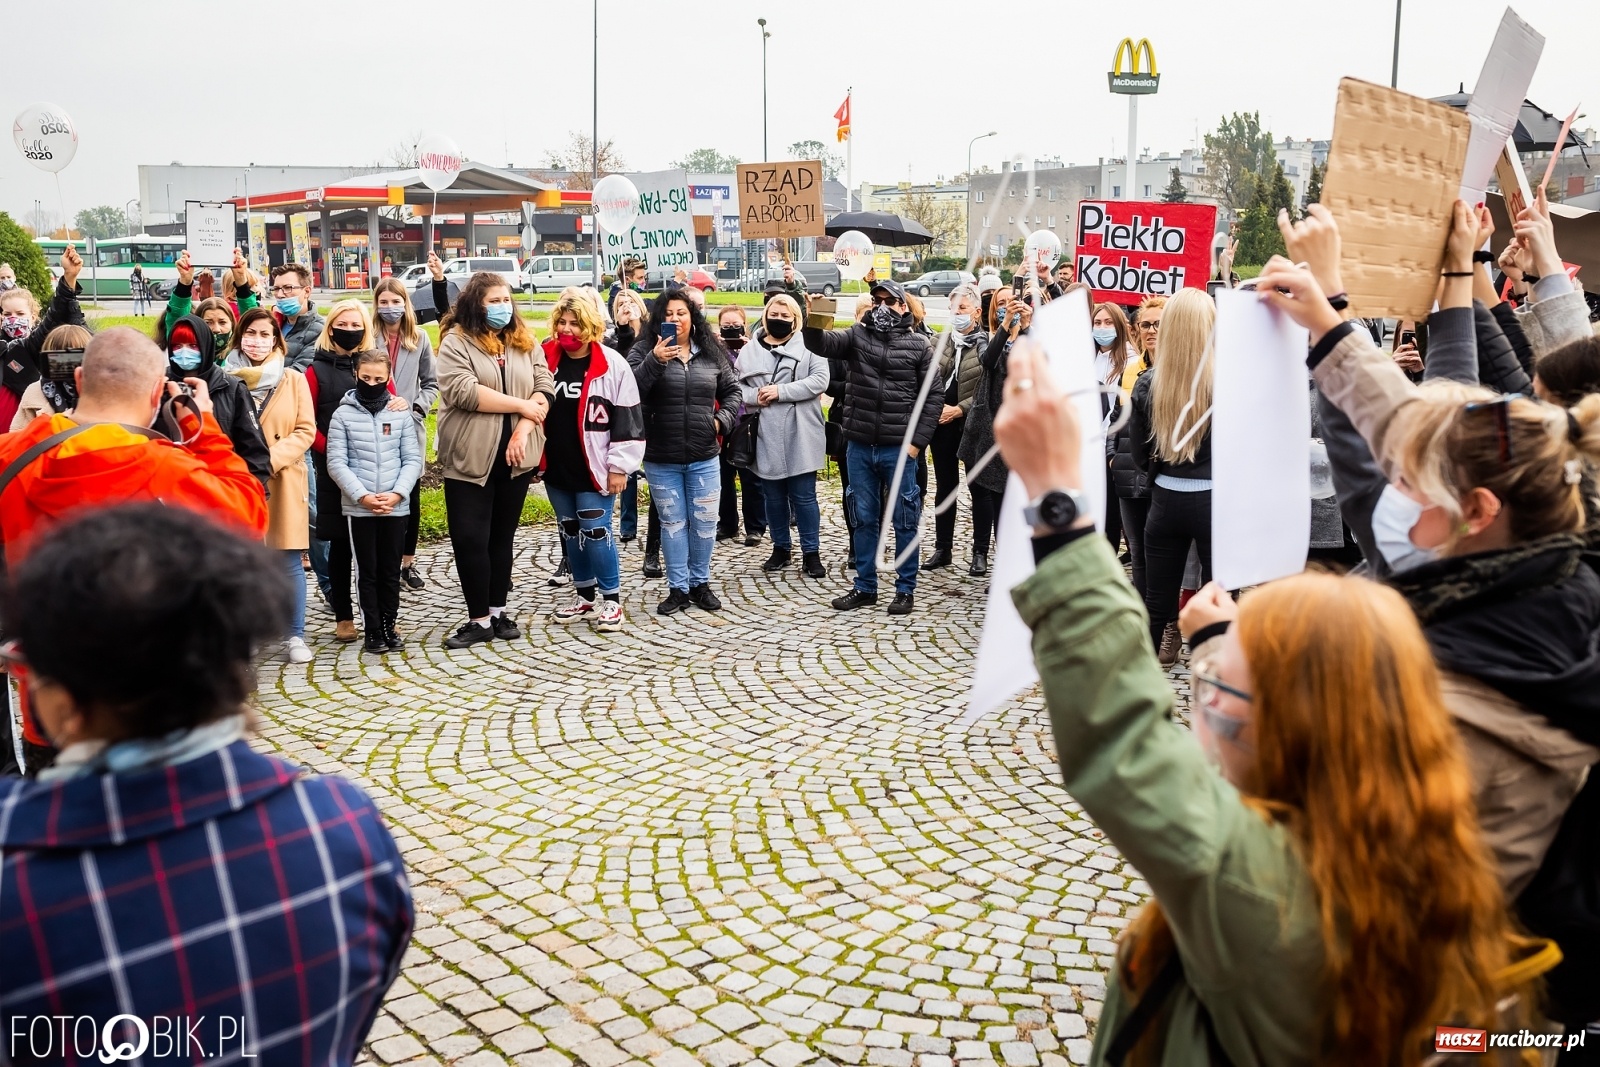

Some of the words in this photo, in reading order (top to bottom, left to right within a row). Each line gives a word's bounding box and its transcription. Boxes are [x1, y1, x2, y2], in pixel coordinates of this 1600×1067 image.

[1112, 79, 1157, 87] McDonald's
[22, 138, 49, 152] hello
[24, 150, 53, 160] 2020
[745, 168, 814, 195] RZĄD
[768, 193, 788, 206] DO
[746, 204, 815, 224] ABORCJI
[1078, 205, 1184, 252] Piekło
[630, 226, 689, 250] WOLNEJ
[657, 251, 694, 268] CHCEMY
[1078, 256, 1184, 295] Kobiet
